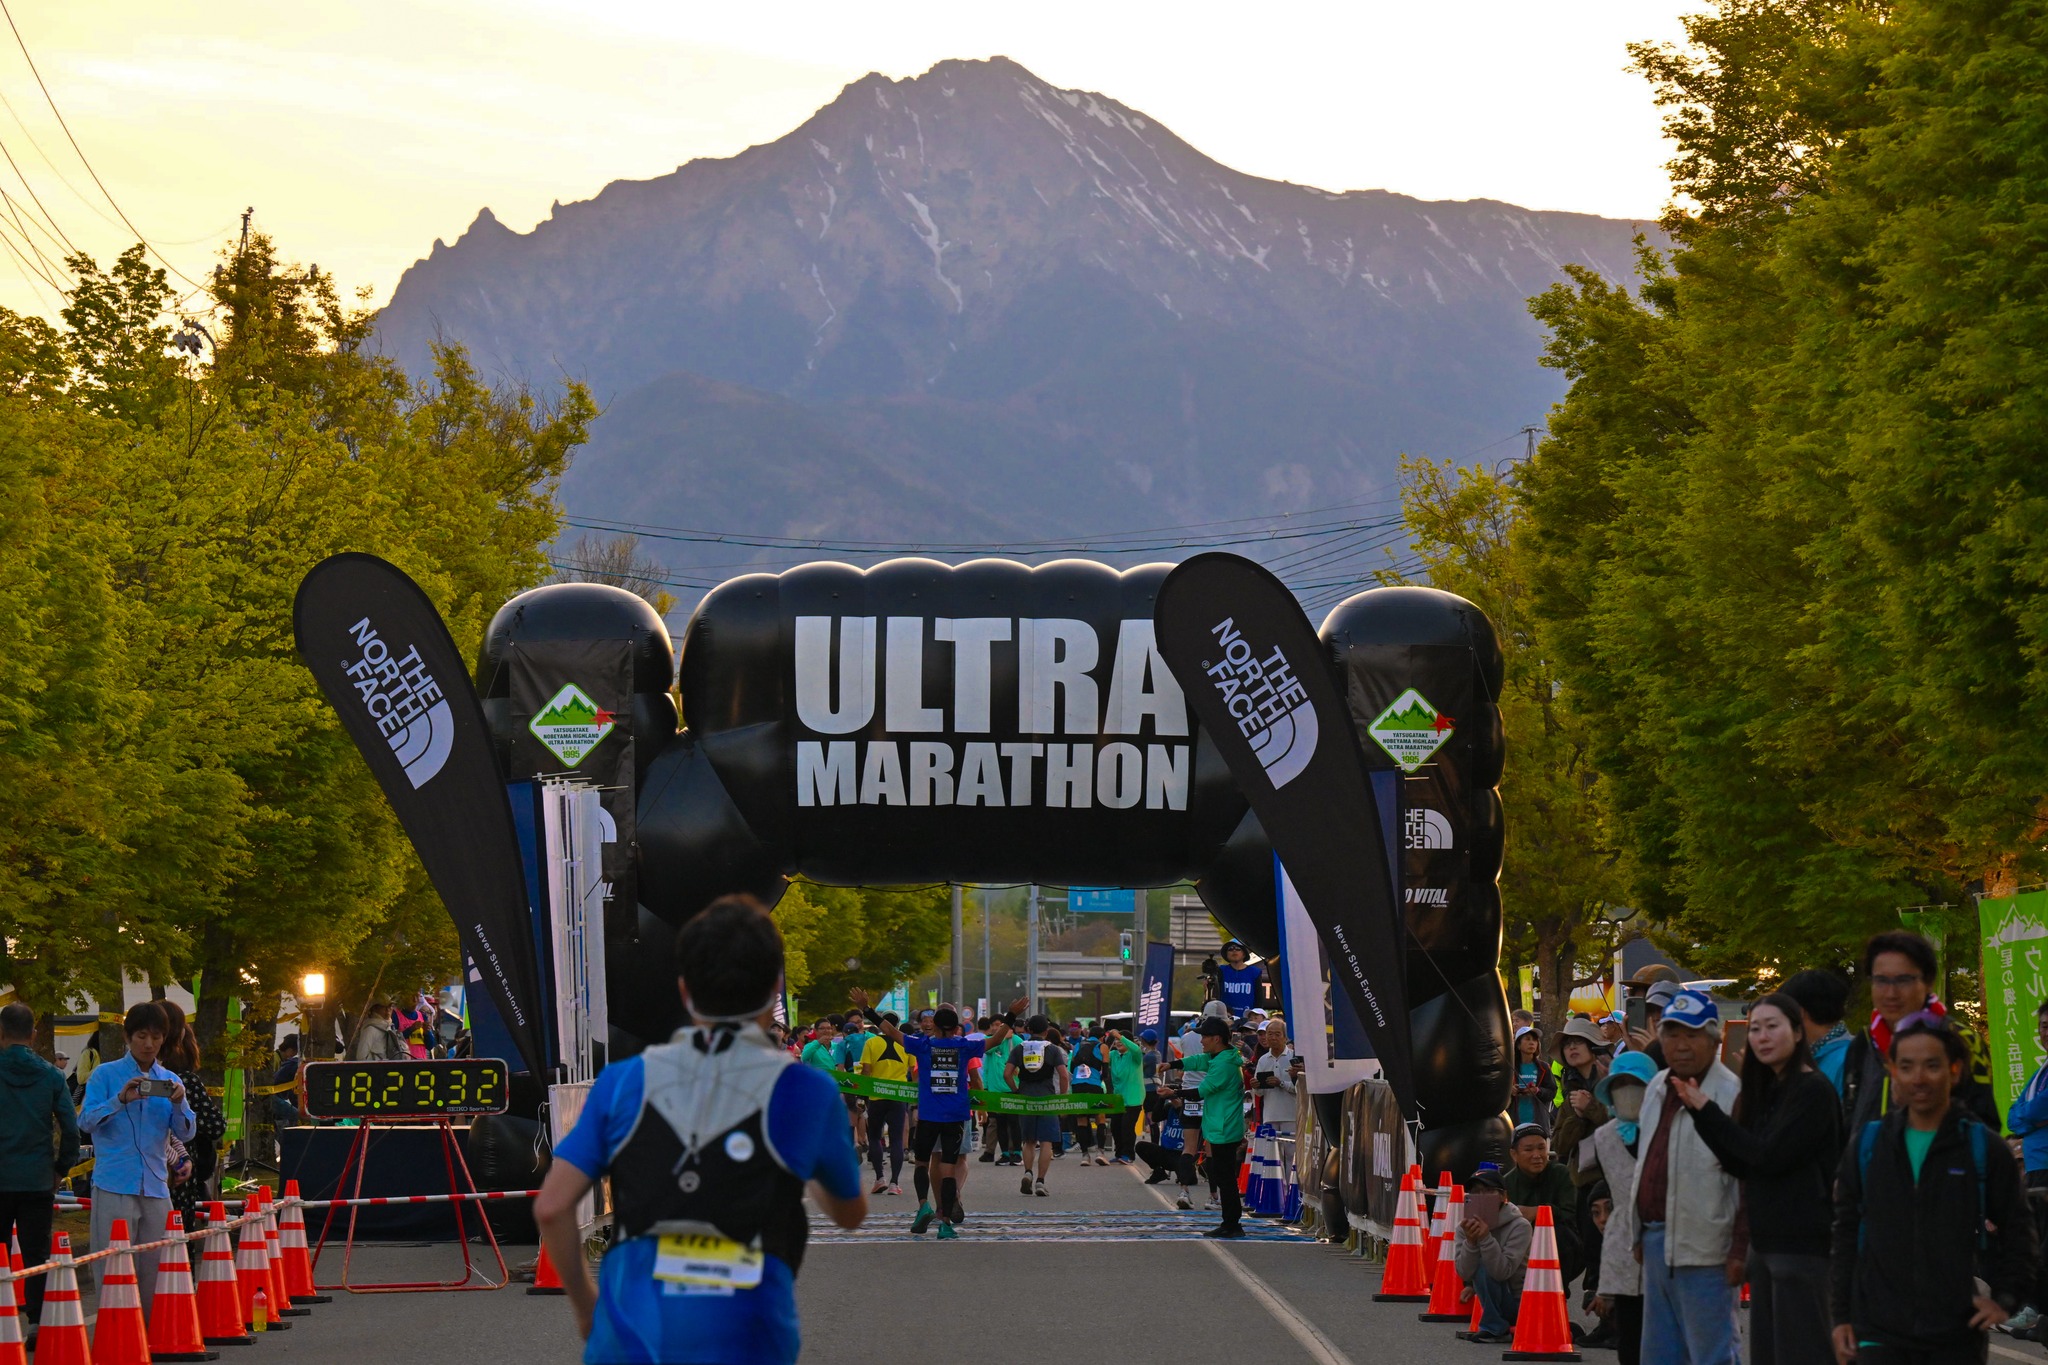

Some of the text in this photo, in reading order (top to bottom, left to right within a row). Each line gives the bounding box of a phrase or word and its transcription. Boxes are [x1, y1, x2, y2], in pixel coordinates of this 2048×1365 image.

[345, 658, 404, 738] FACE
[348, 616, 424, 724] NORTH
[397, 643, 444, 709] THE
[795, 615, 1189, 736] ULTRA
[1206, 658, 1266, 738] FACE
[1210, 616, 1287, 724] NORTH
[1261, 644, 1308, 710] THE
[562, 750, 580, 758] 1995
[796, 740, 1189, 811] MARATHON
[1402, 756, 1420, 764] 1995
[1414, 888, 1448, 904] VITAL
[474, 924, 526, 1026] Never Stop Exploring
[1224, 982, 1252, 994] PHOTO
[1334, 924, 1386, 1028] Never Stop Exploring
[1026, 1102, 1088, 1112] ULTRAMARATHON
